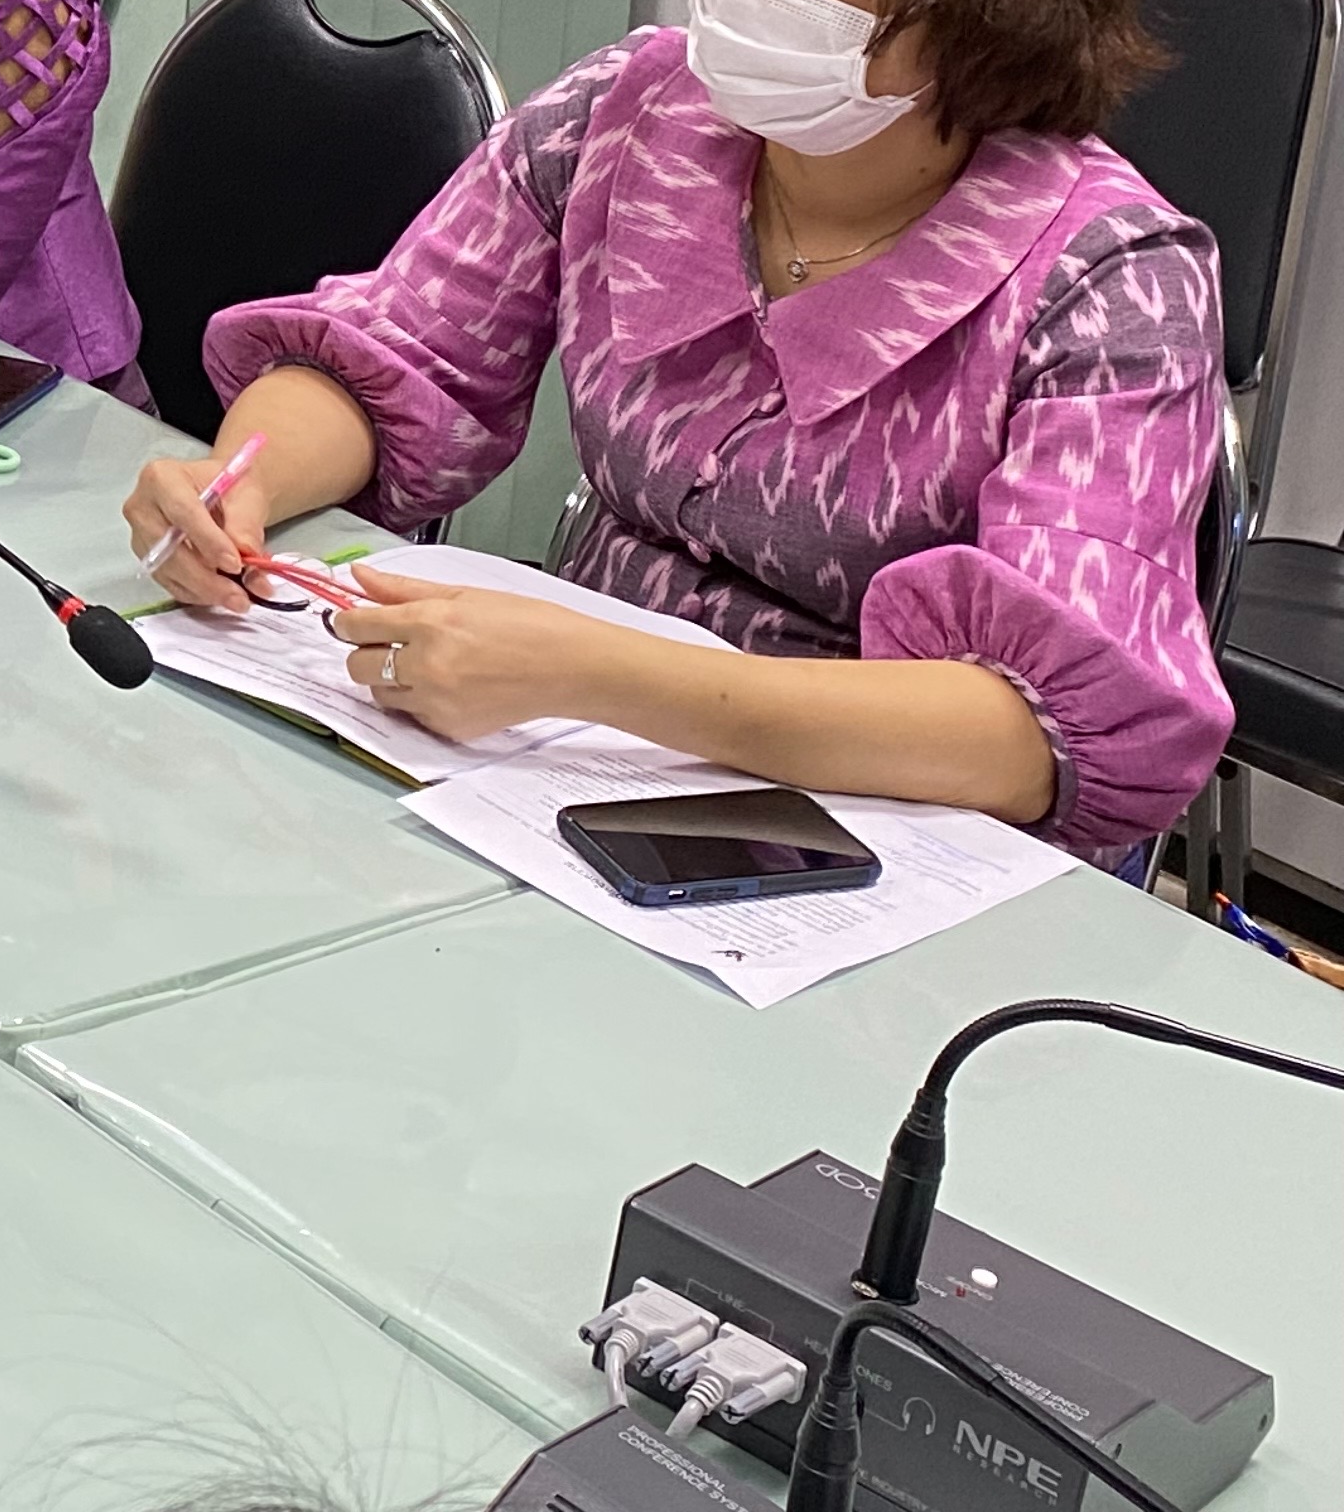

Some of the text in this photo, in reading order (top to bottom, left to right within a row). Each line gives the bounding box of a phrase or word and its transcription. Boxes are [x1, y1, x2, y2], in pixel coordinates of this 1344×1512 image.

[617, 1430, 709, 1493] CONFERENCE
[626, 1424, 726, 1493] PROFESSIONAL
[955, 1418, 1062, 1498] NPE
